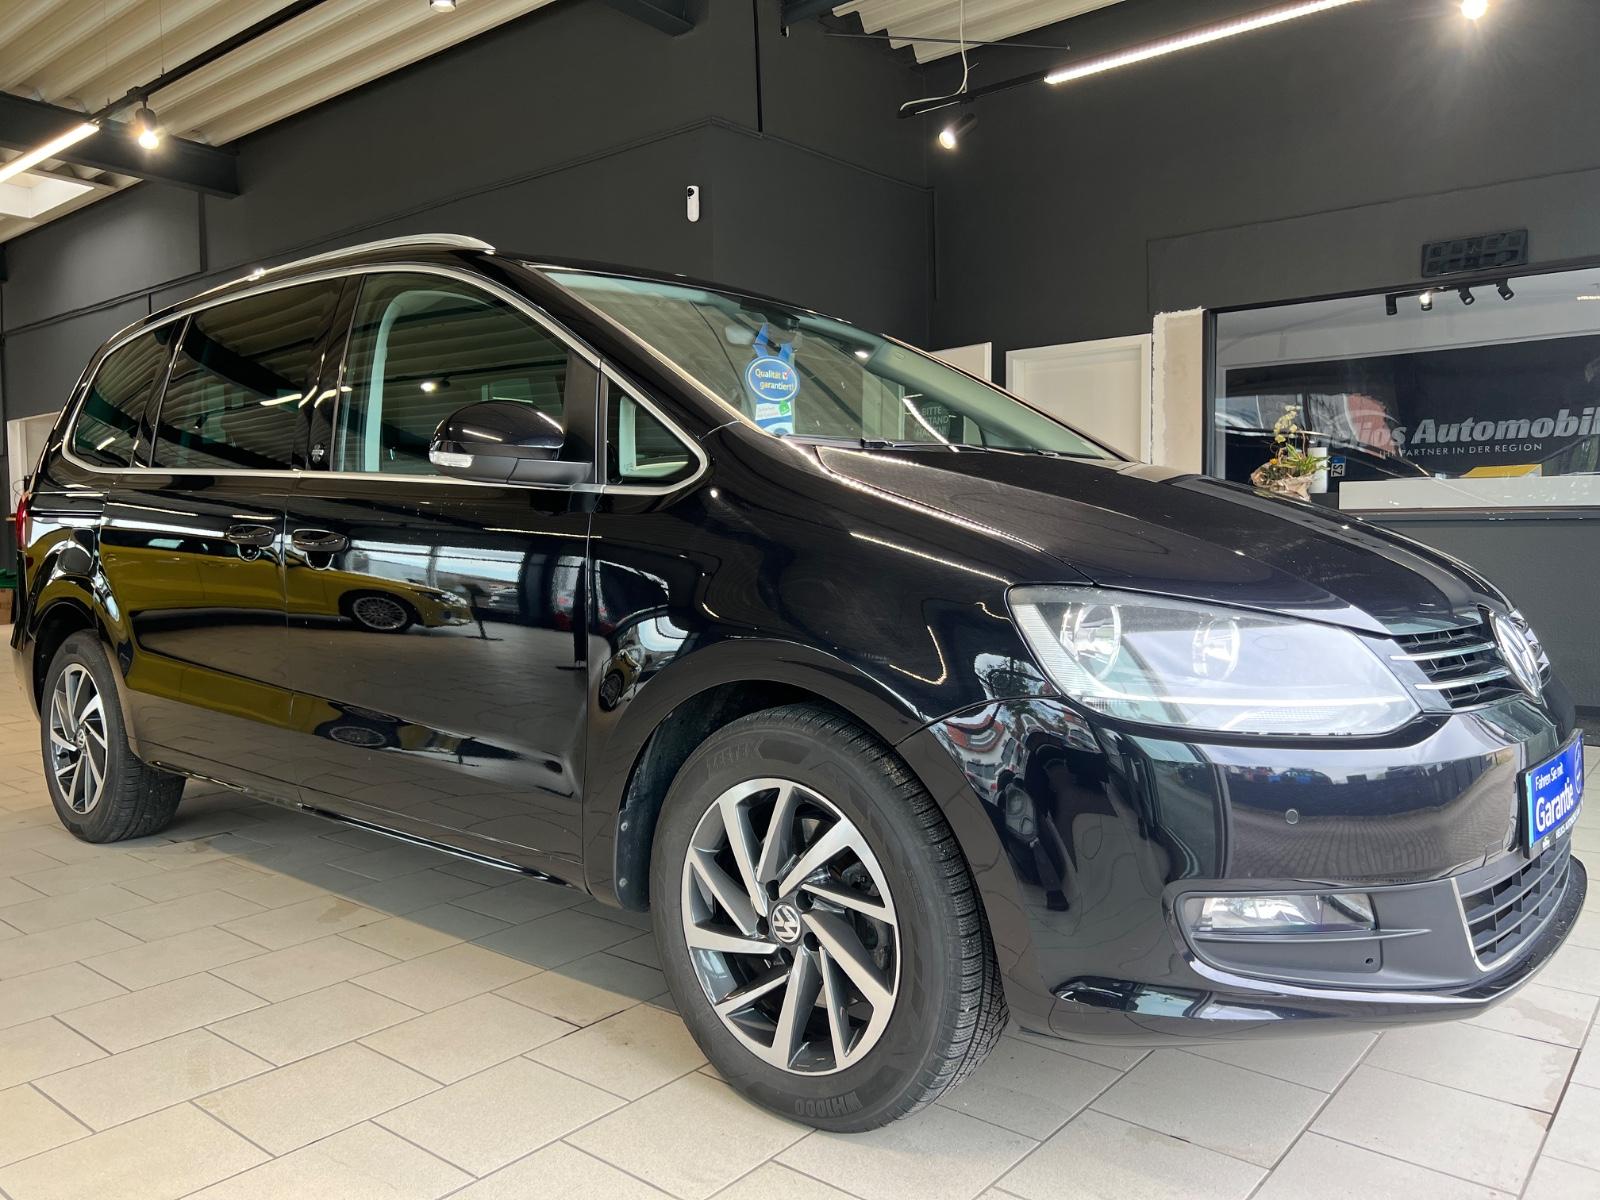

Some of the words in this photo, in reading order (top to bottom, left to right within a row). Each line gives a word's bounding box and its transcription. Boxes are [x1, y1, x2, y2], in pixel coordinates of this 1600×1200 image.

[1401, 448, 1449, 457] PARTNER
[1452, 447, 1466, 455] IN
[1468, 445, 1490, 454] DER
[1495, 443, 1542, 453] REGION
[1535, 777, 1574, 832] Garantie
